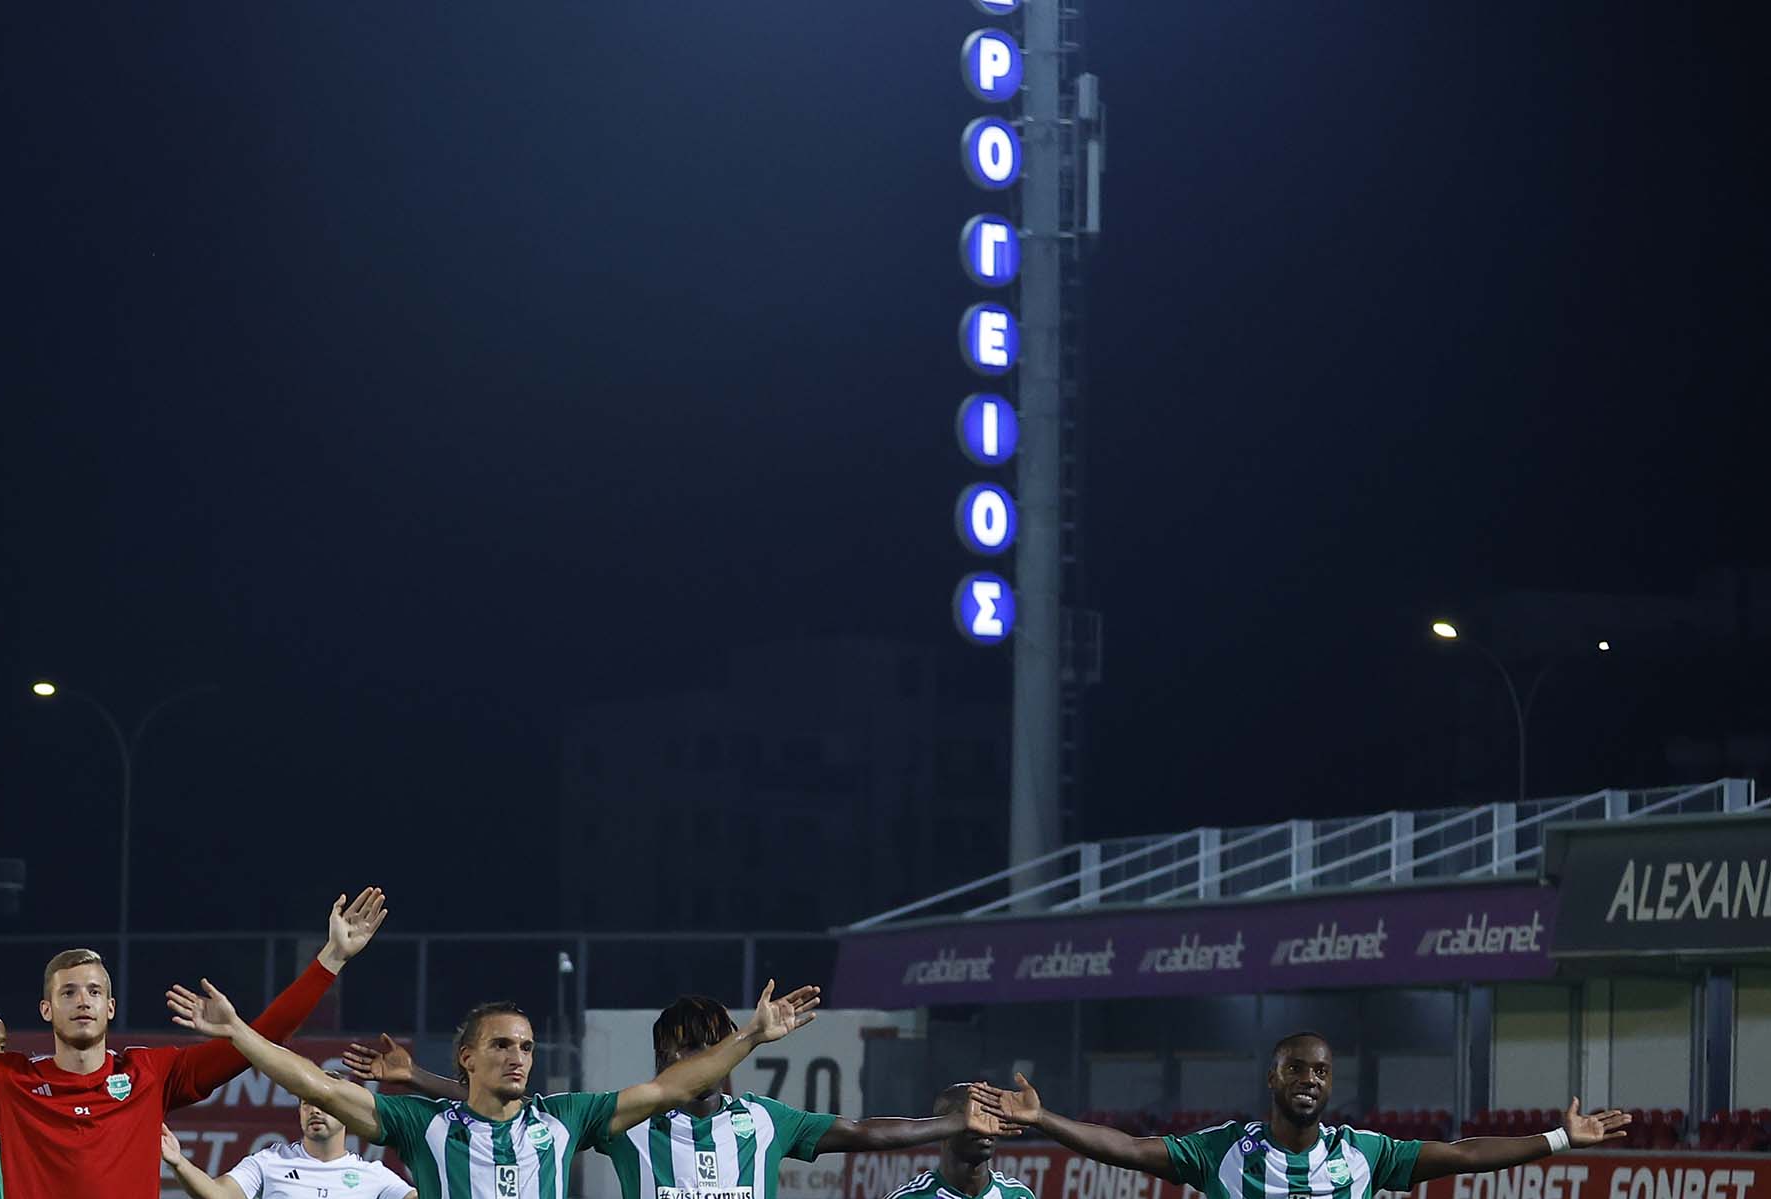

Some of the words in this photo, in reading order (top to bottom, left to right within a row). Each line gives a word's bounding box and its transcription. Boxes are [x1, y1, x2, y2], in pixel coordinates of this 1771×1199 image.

[972, 0, 1015, 637] ΡΟΓΕΙΟΣ
[1605, 859, 1771, 923] ALEXAN
[1155, 930, 1245, 973] cablenet
[1288, 919, 1389, 964] cablenet
[1434, 911, 1545, 956] cablenet
[74, 1106, 91, 1115] 91
[316, 1187, 328, 1198] TJ
